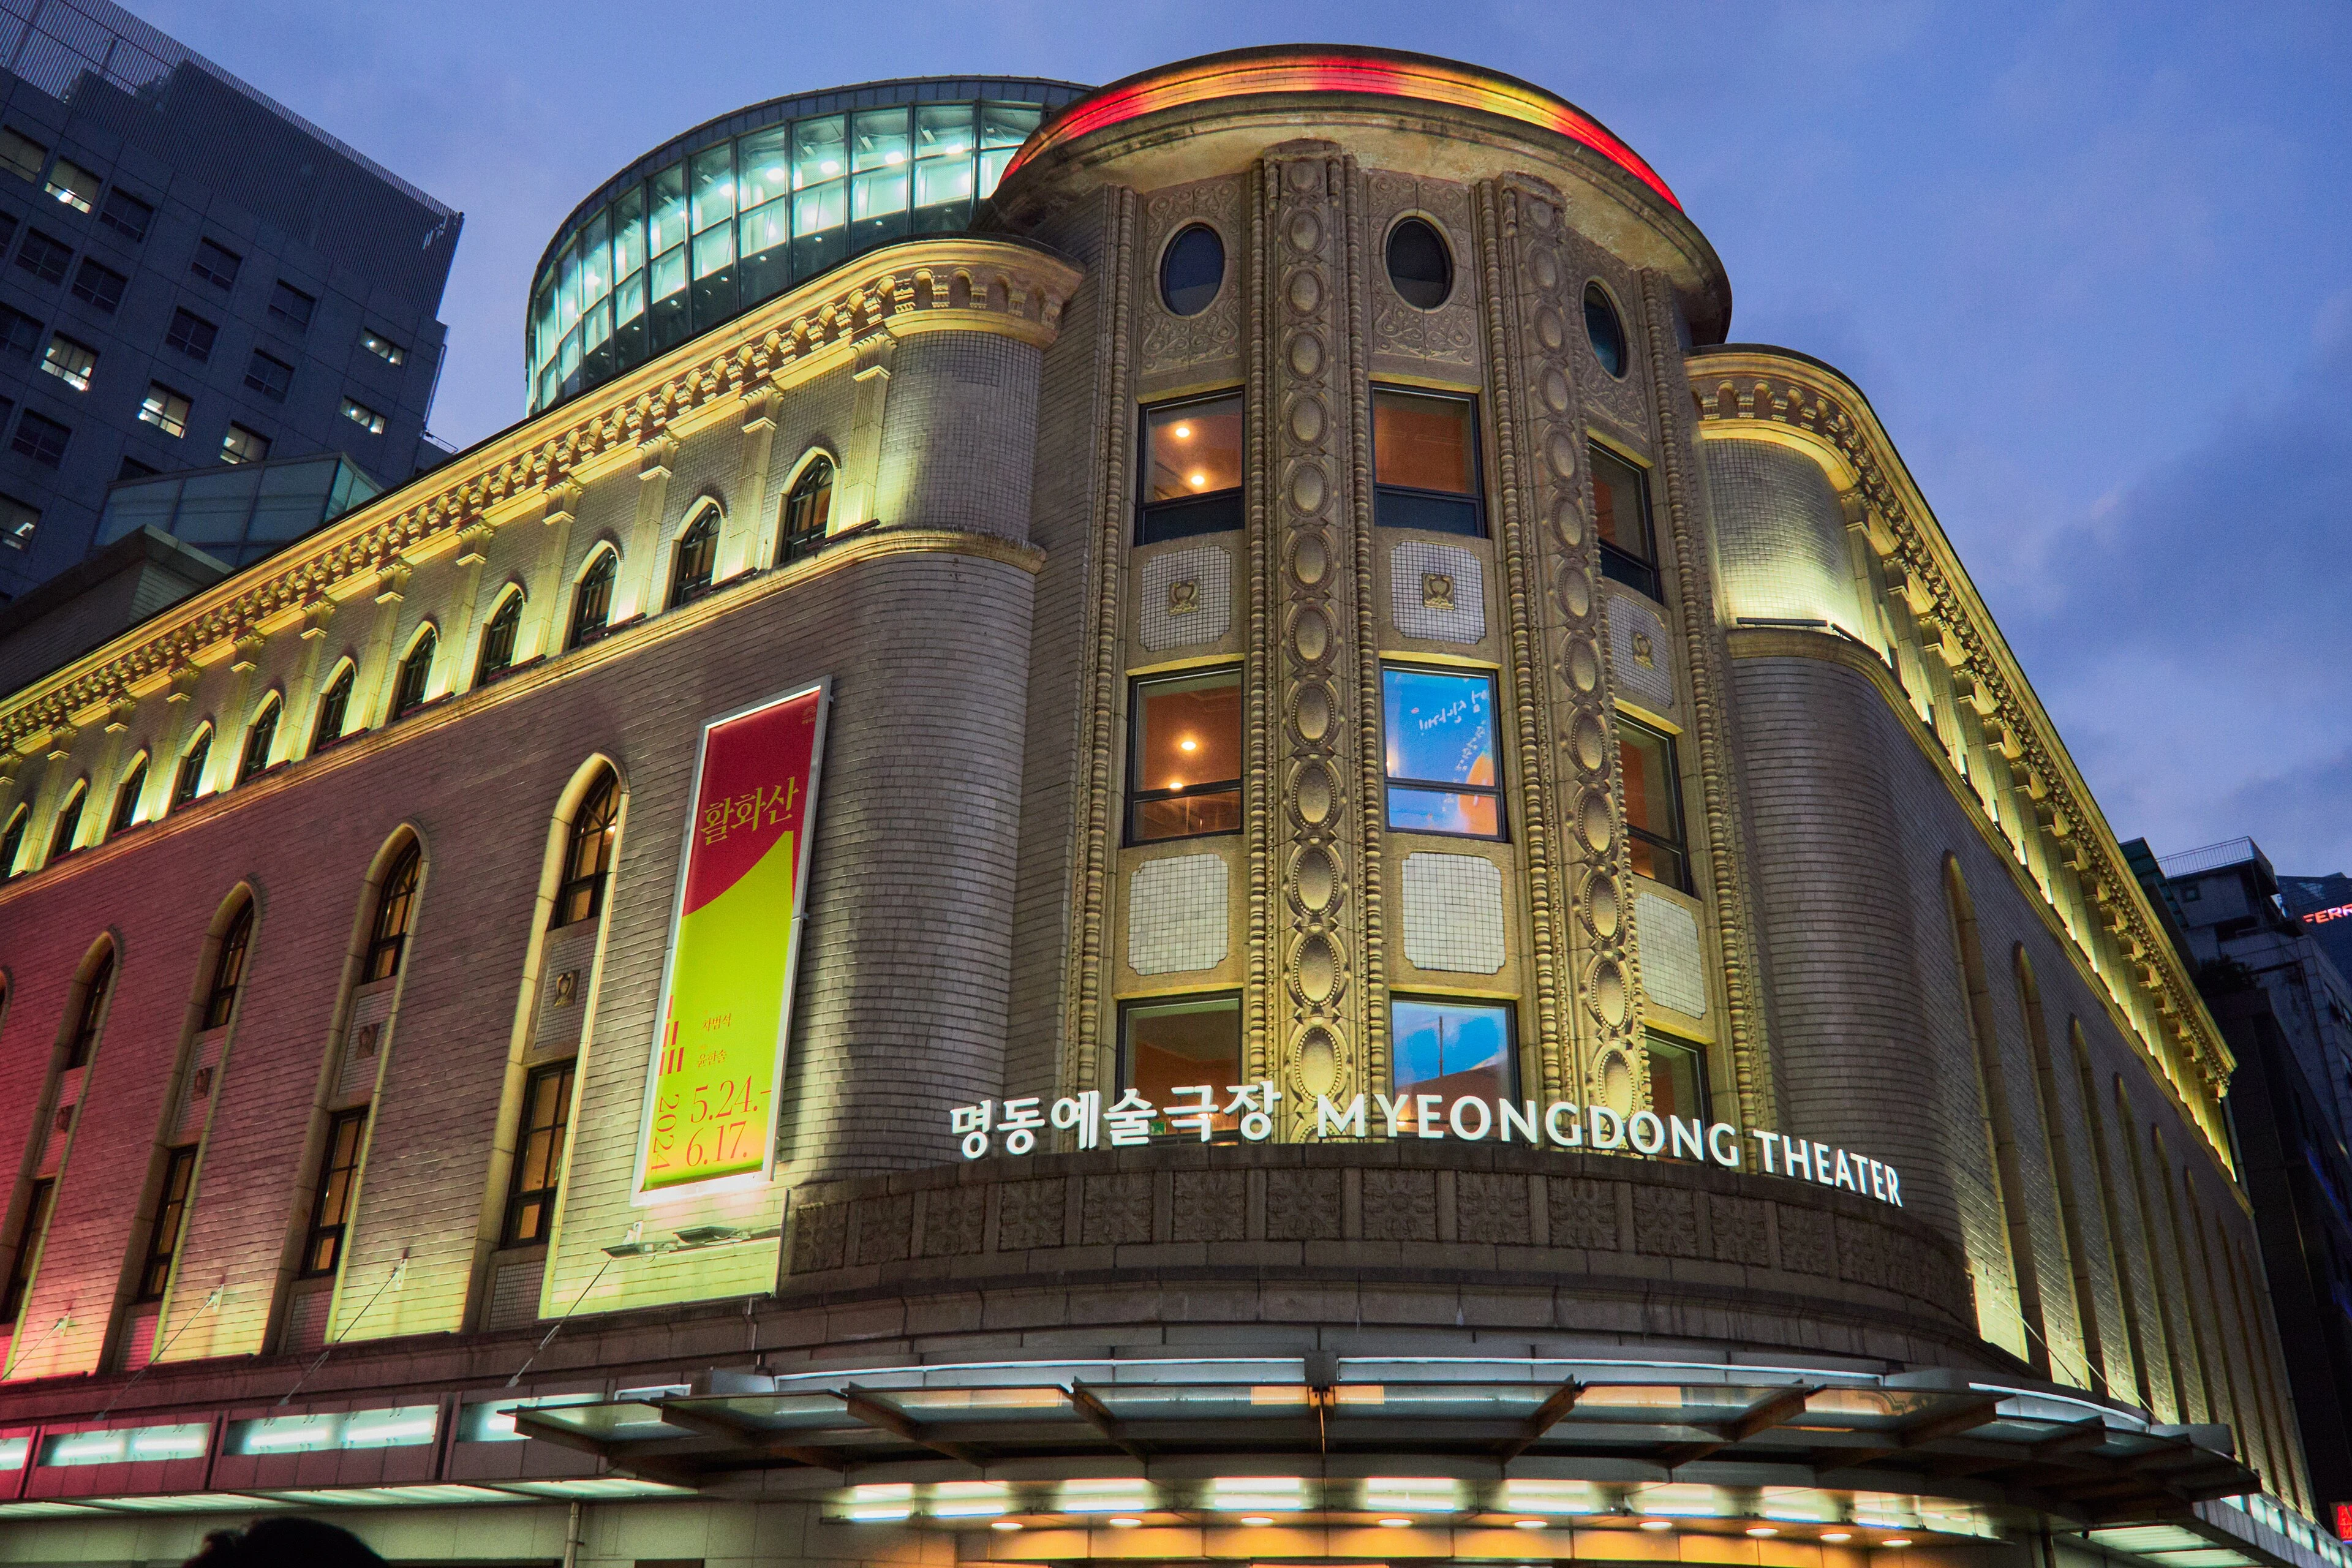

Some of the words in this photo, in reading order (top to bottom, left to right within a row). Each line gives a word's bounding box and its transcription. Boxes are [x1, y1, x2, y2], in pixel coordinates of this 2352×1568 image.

[701, 776, 799, 846] 활화산
[702, 1012, 732, 1032] 차범석
[697, 1049, 727, 1068] 윤한솔
[651, 1093, 680, 1174] 2024
[687, 1120, 747, 1167] 6.17.
[950, 1080, 1282, 1159] 명동예술극장
[1316, 1093, 1741, 1168] MYEONGDONG
[1752, 1129, 1903, 1208] THEATER
